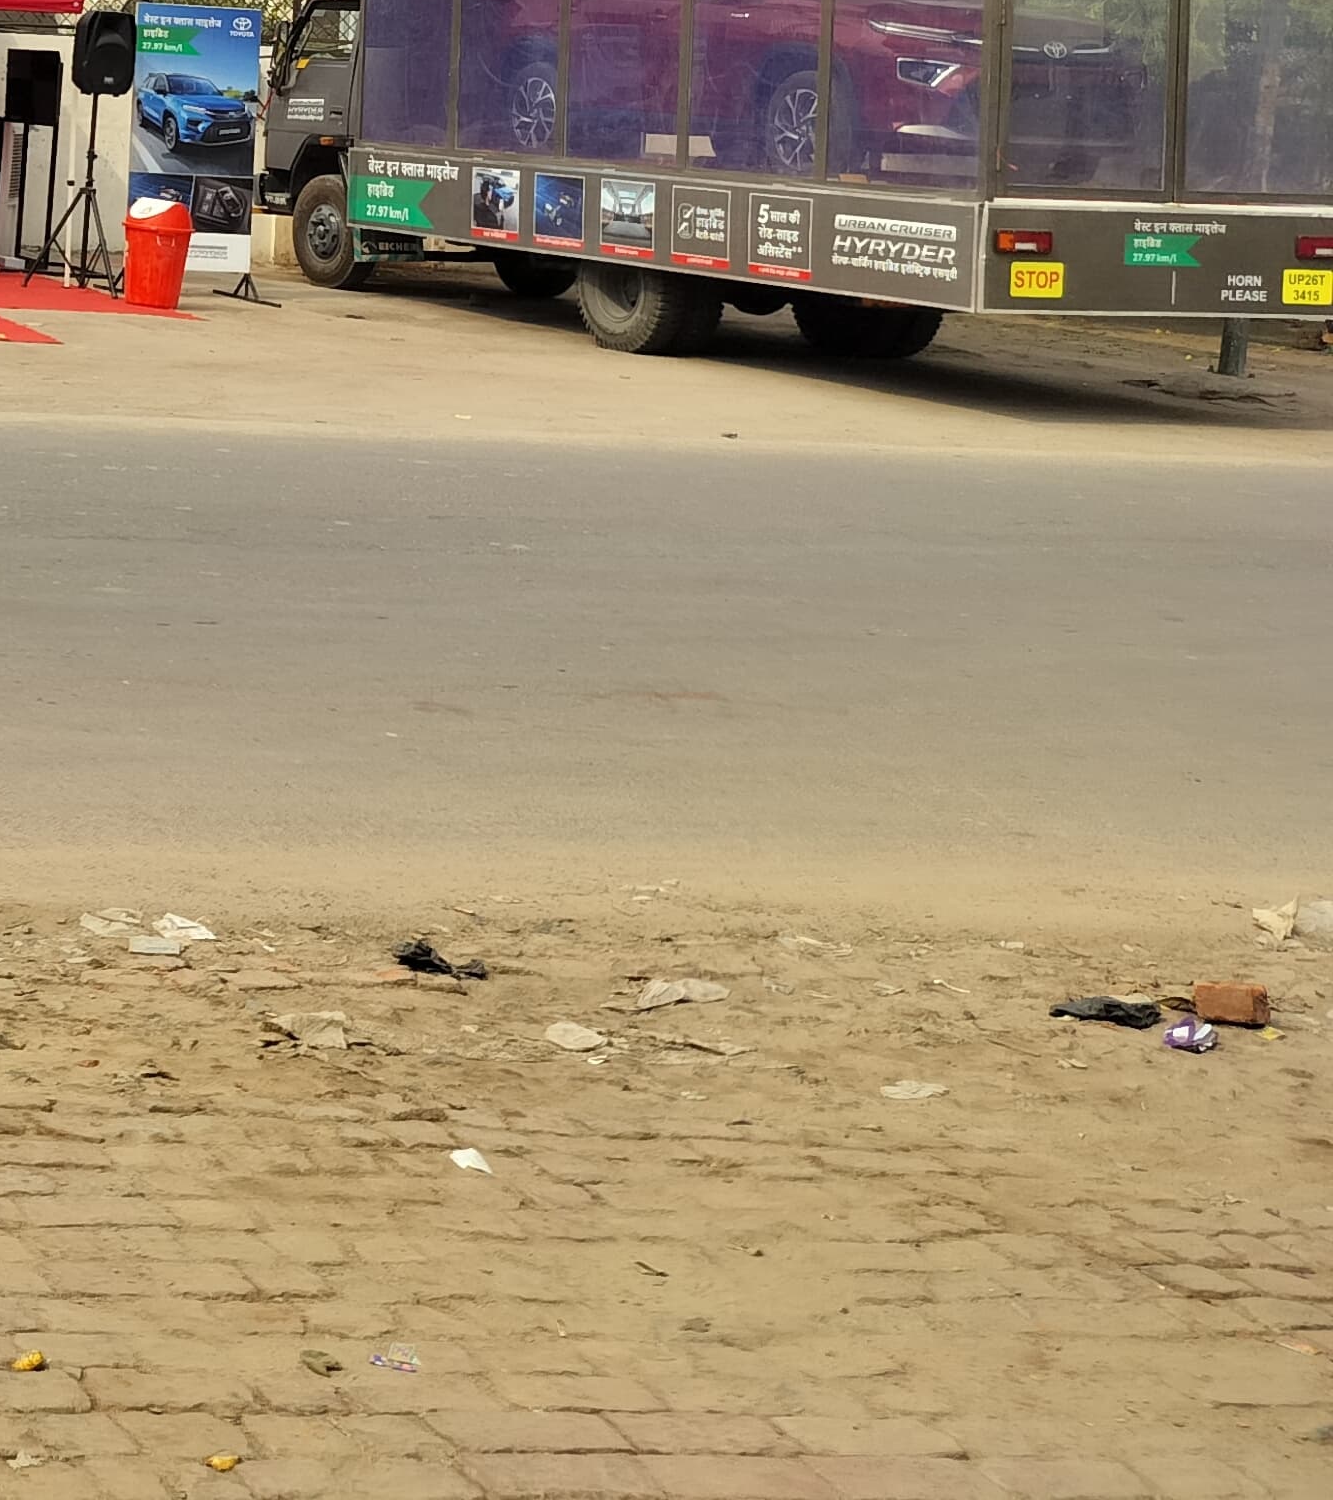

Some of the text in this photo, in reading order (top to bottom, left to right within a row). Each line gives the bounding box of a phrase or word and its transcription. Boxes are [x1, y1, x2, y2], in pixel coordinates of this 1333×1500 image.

[368, 155, 385, 174] बेस्ट
[386, 161, 399, 177] इन
[401, 162, 425, 177] क्लास
[366, 204, 388, 217] 27.97
[757, 204, 770, 223] 5
[838, 218, 953, 239] URBAN CRUISER
[1154, 222, 1167, 234] इन
[833, 235, 956, 264] HYRYDER
[1014, 270, 1060, 289] STOP
[1227, 275, 1262, 287] HORN
[1288, 274, 1325, 285] UP26T
[1220, 289, 1268, 302] PLEASE
[1293, 290, 1320, 301] 3415
